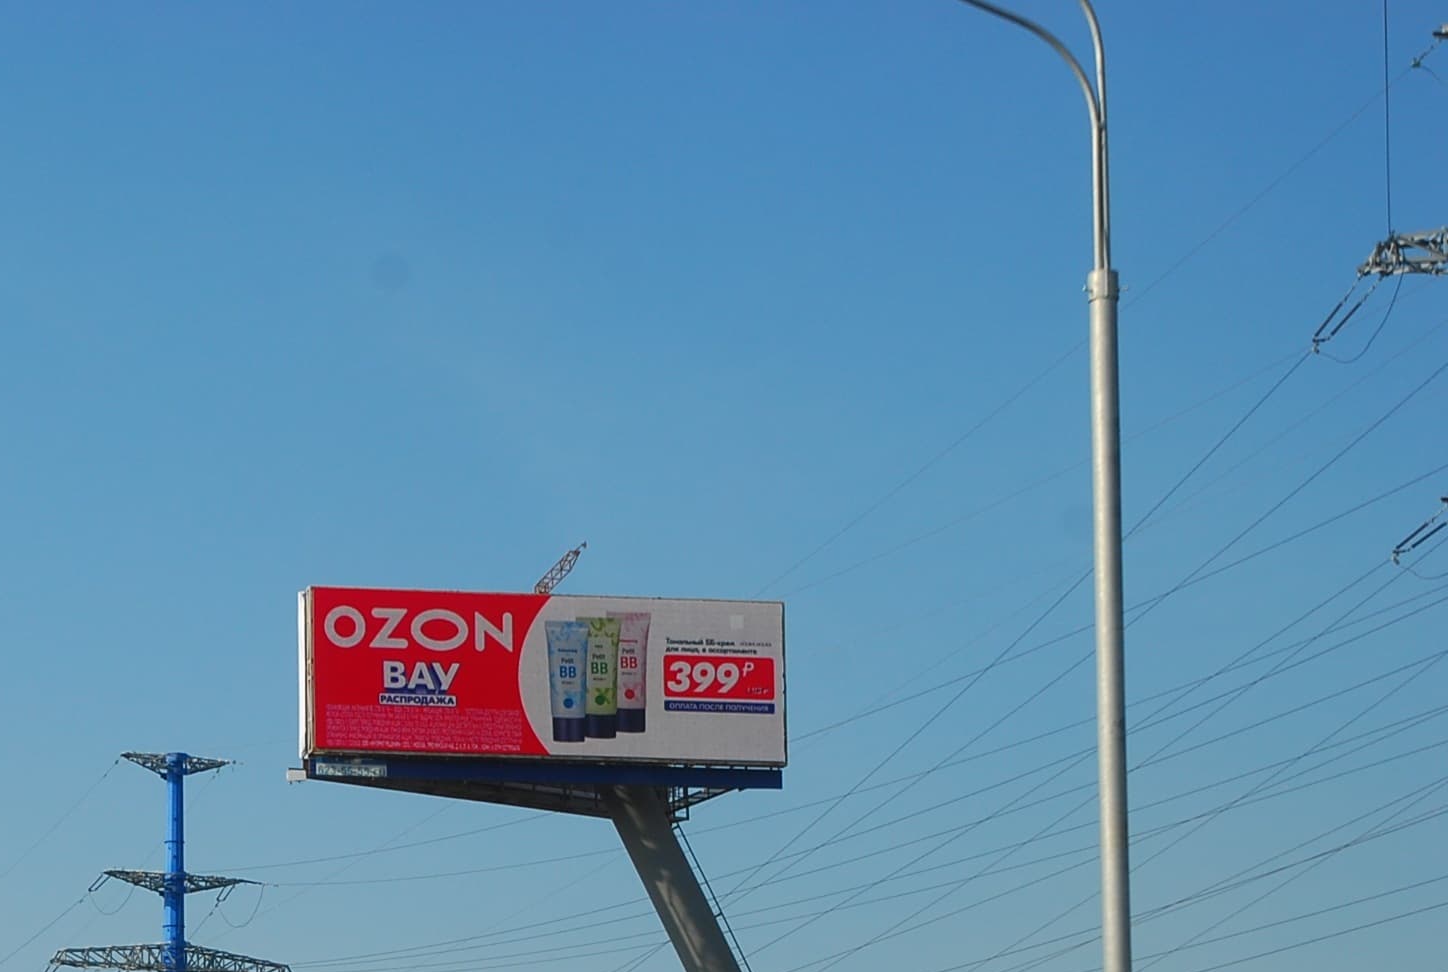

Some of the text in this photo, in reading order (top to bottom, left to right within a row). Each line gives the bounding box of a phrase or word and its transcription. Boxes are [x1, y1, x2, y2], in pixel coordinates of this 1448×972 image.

[324, 605, 513, 653] OZON
[591, 661, 608, 674] BB
[620, 656, 638, 669] BB
[559, 666, 577, 678] BB
[380, 694, 455, 706] РАСПРОДАЖА
